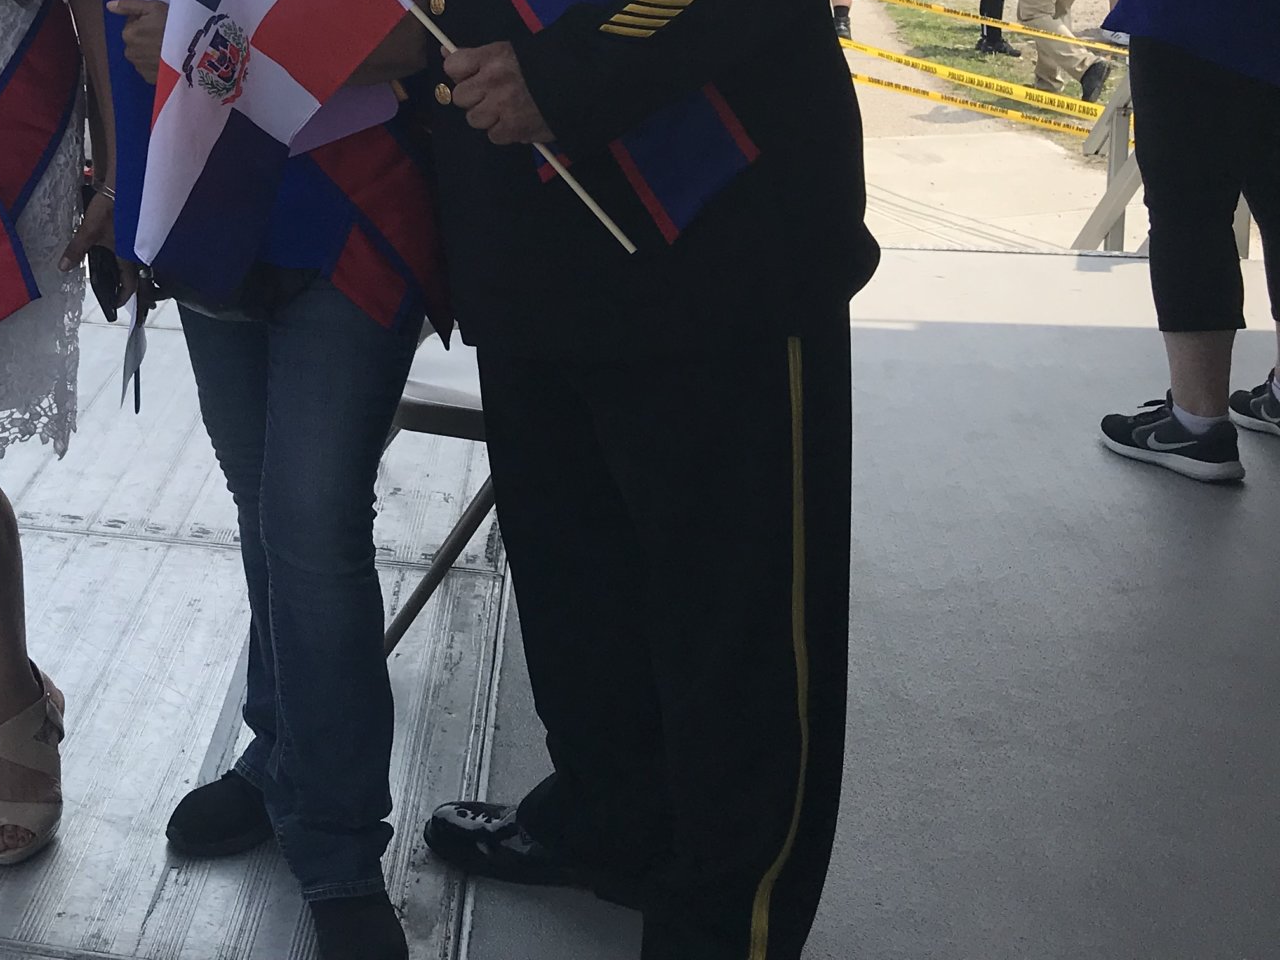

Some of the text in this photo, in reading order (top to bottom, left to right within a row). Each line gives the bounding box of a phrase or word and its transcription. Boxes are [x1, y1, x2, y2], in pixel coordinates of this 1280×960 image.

[995, 83, 1014, 95] CROSS
[1025, 91, 1098, 117] POLICE LINE DO NOT CROSS
